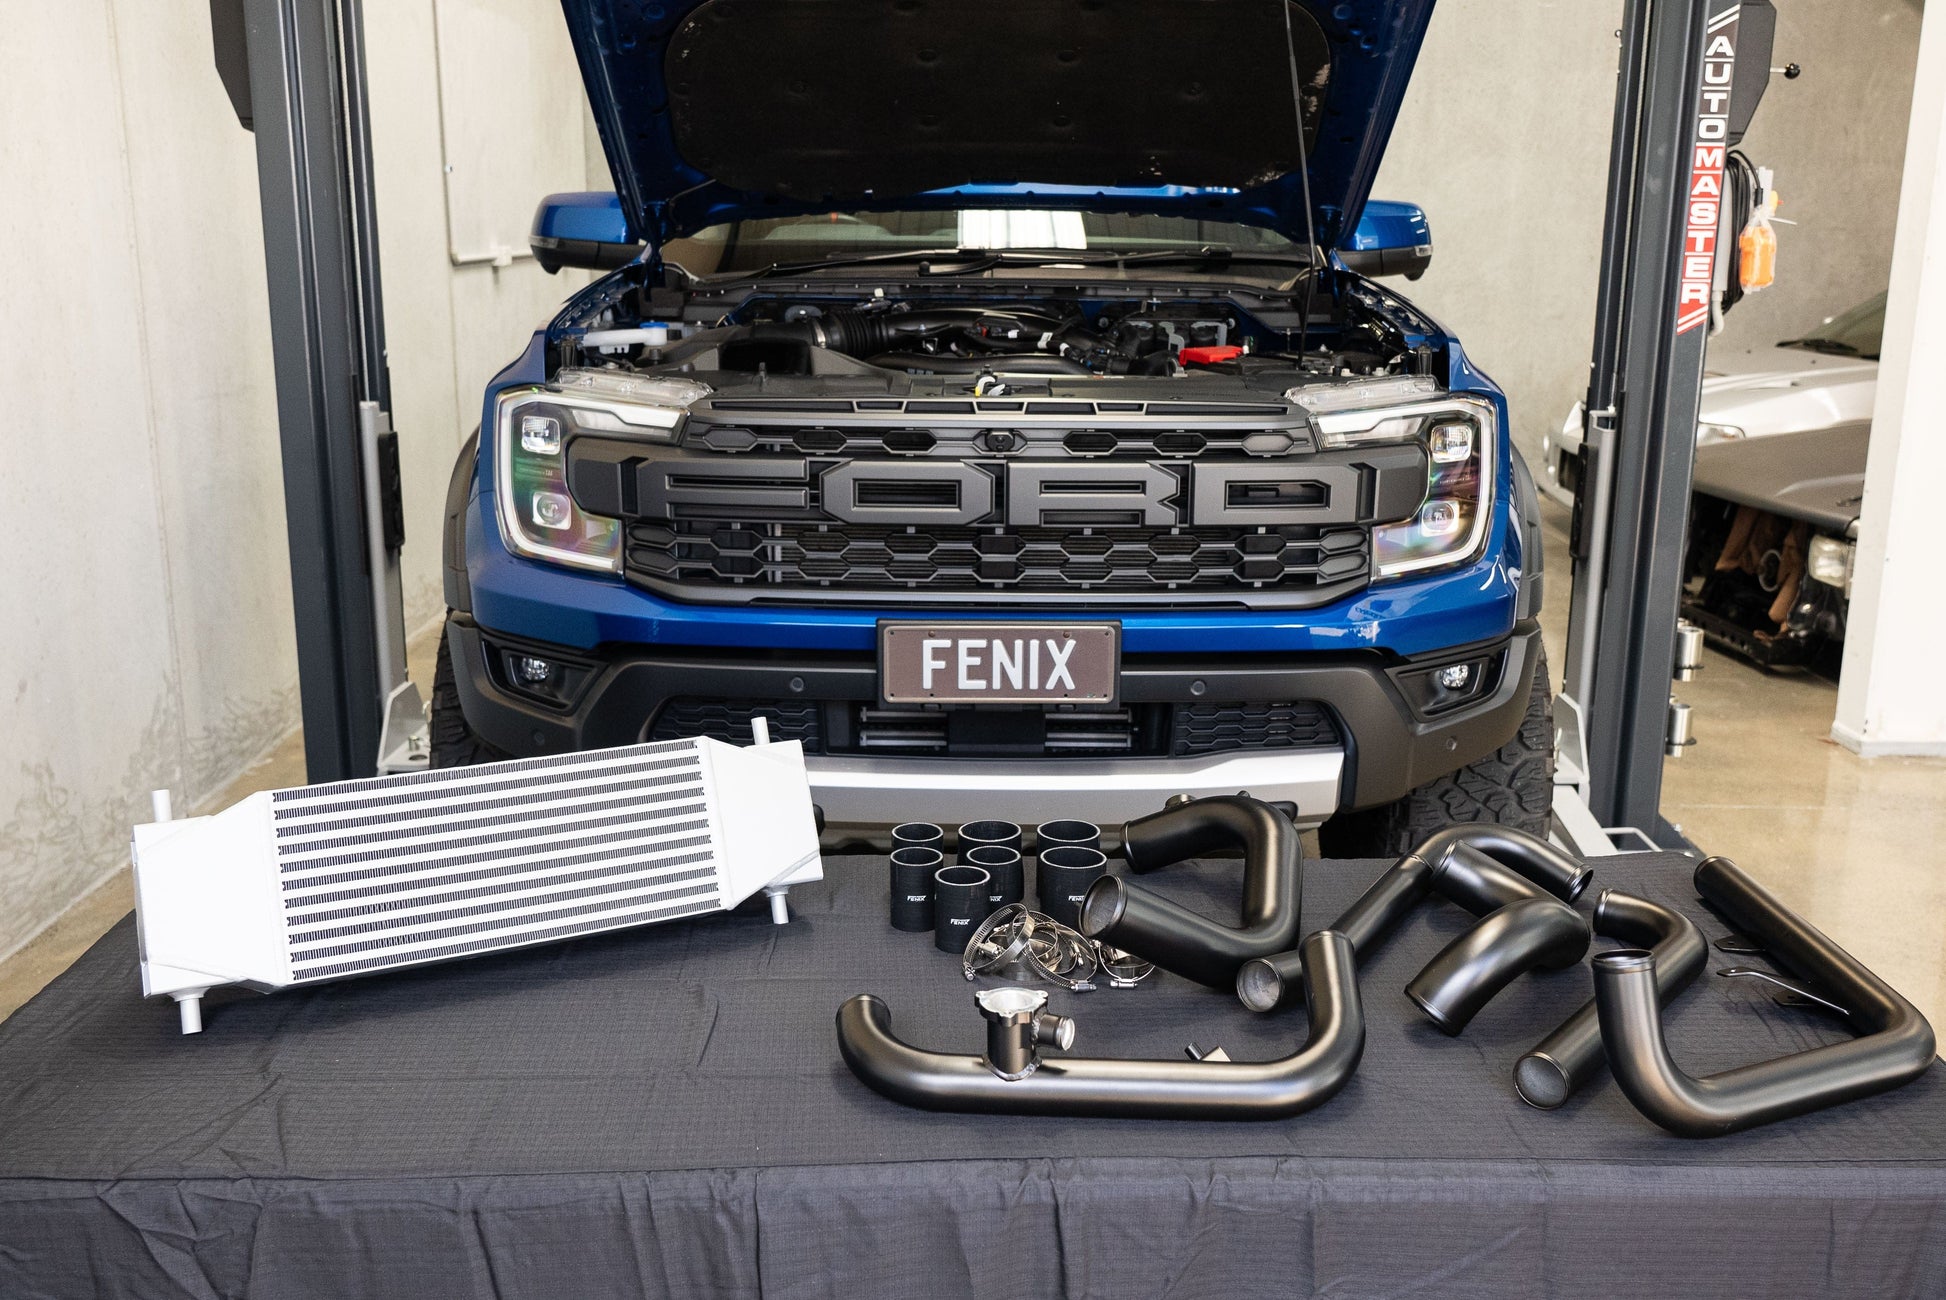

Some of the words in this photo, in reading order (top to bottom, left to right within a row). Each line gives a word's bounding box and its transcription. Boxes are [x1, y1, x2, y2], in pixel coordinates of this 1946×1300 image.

[1681, 36, 1734, 304] AUTOMASTER
[637, 457, 1360, 527] FORD
[922, 639, 1076, 690] FENIX
[950, 918, 971, 926] FENIX
